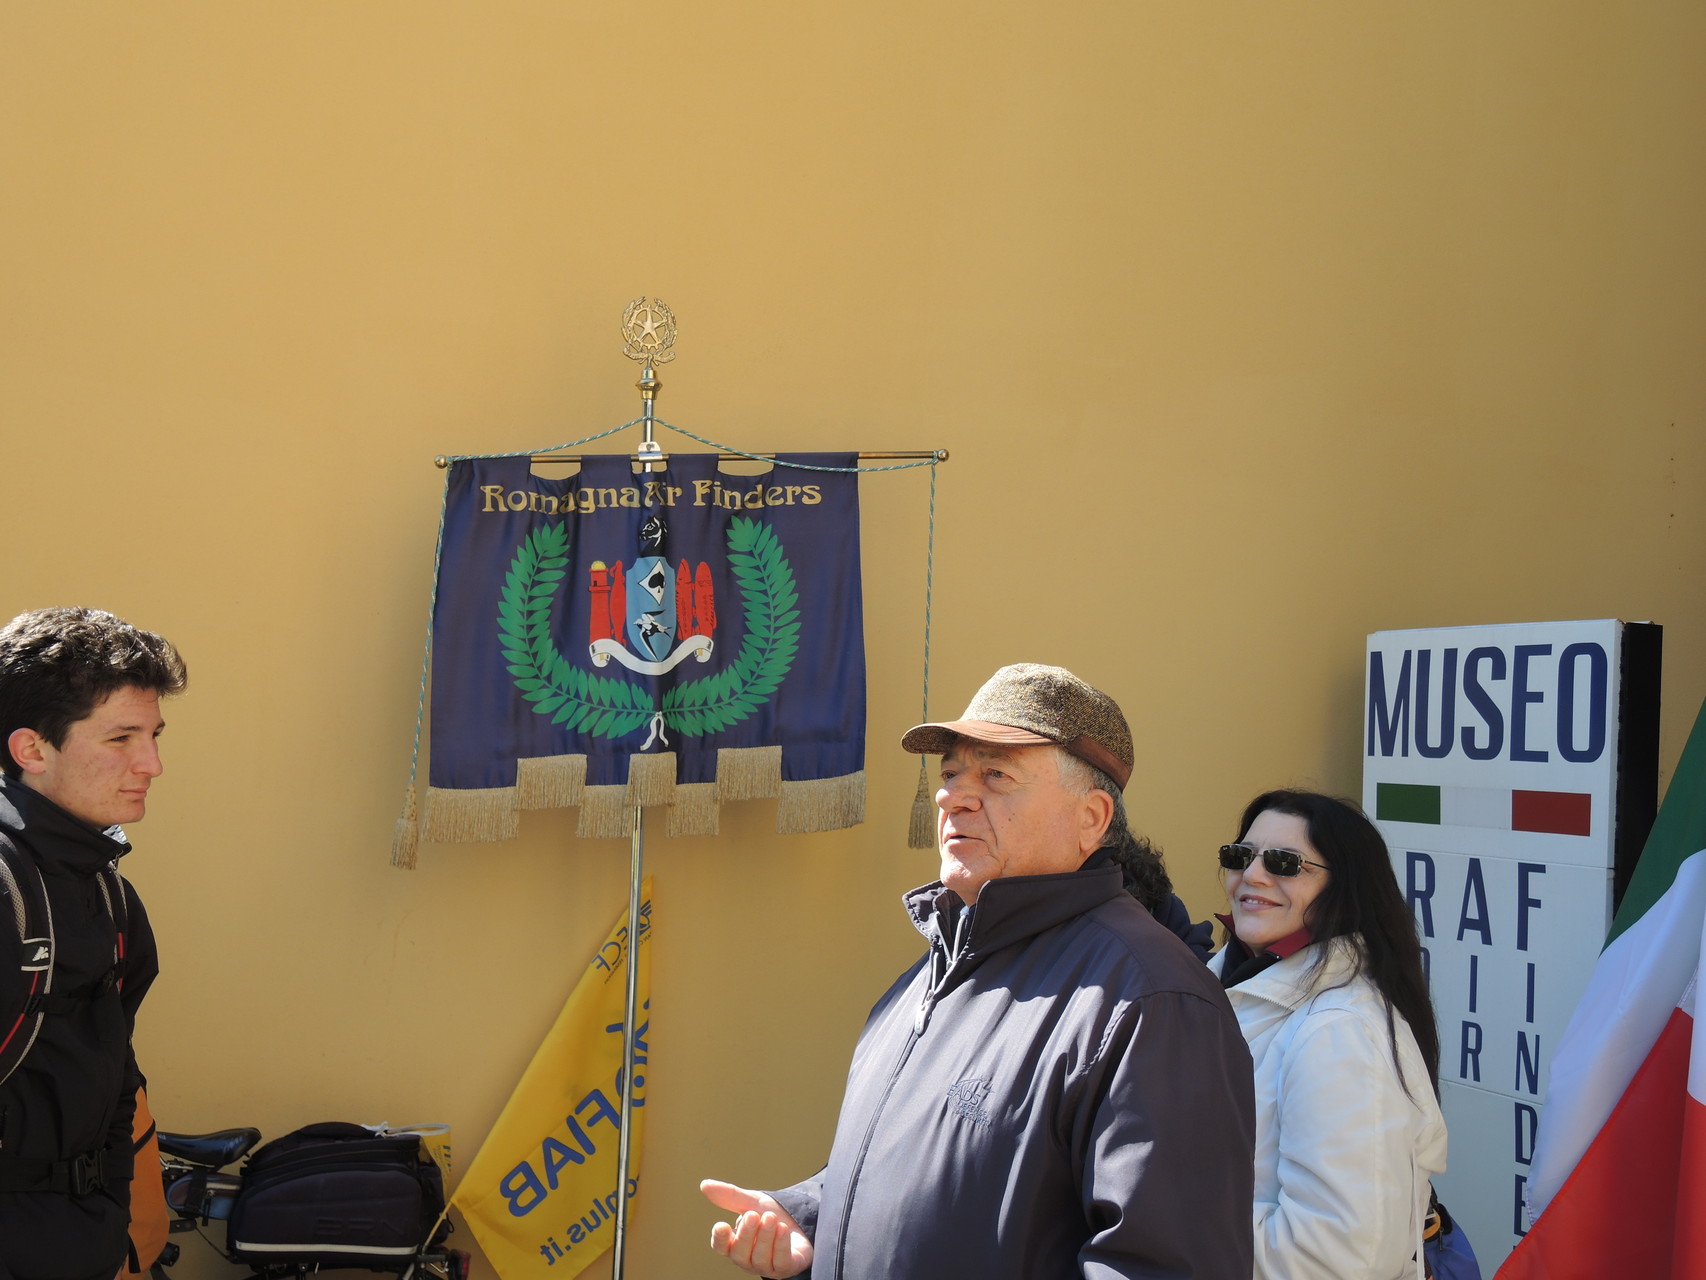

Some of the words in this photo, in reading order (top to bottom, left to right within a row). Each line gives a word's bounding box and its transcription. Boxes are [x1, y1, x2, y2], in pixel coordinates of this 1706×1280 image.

[480, 484, 641, 515] Romagna
[644, 481, 683, 507] Air
[692, 479, 823, 510] Finders
[1367, 642, 1608, 763] MUSEO
[1513, 862, 1547, 1250] FINDE
